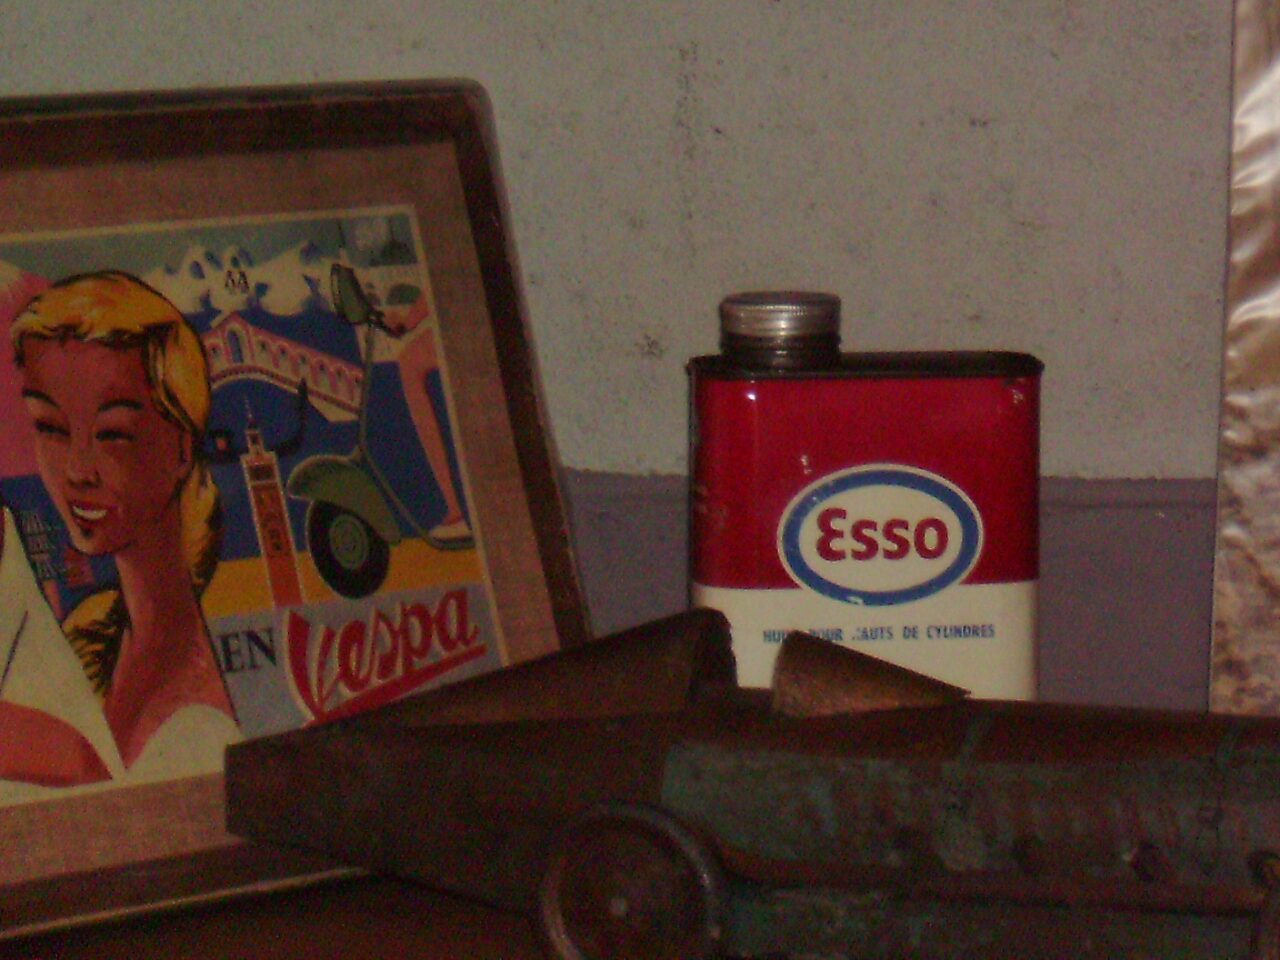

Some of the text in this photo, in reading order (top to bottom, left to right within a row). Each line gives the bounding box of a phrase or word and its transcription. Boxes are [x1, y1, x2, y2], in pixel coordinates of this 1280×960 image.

[217, 586, 488, 723] EN Vespa
[903, 625, 919, 639] DE
[926, 624, 995, 639] CYLINDRES
